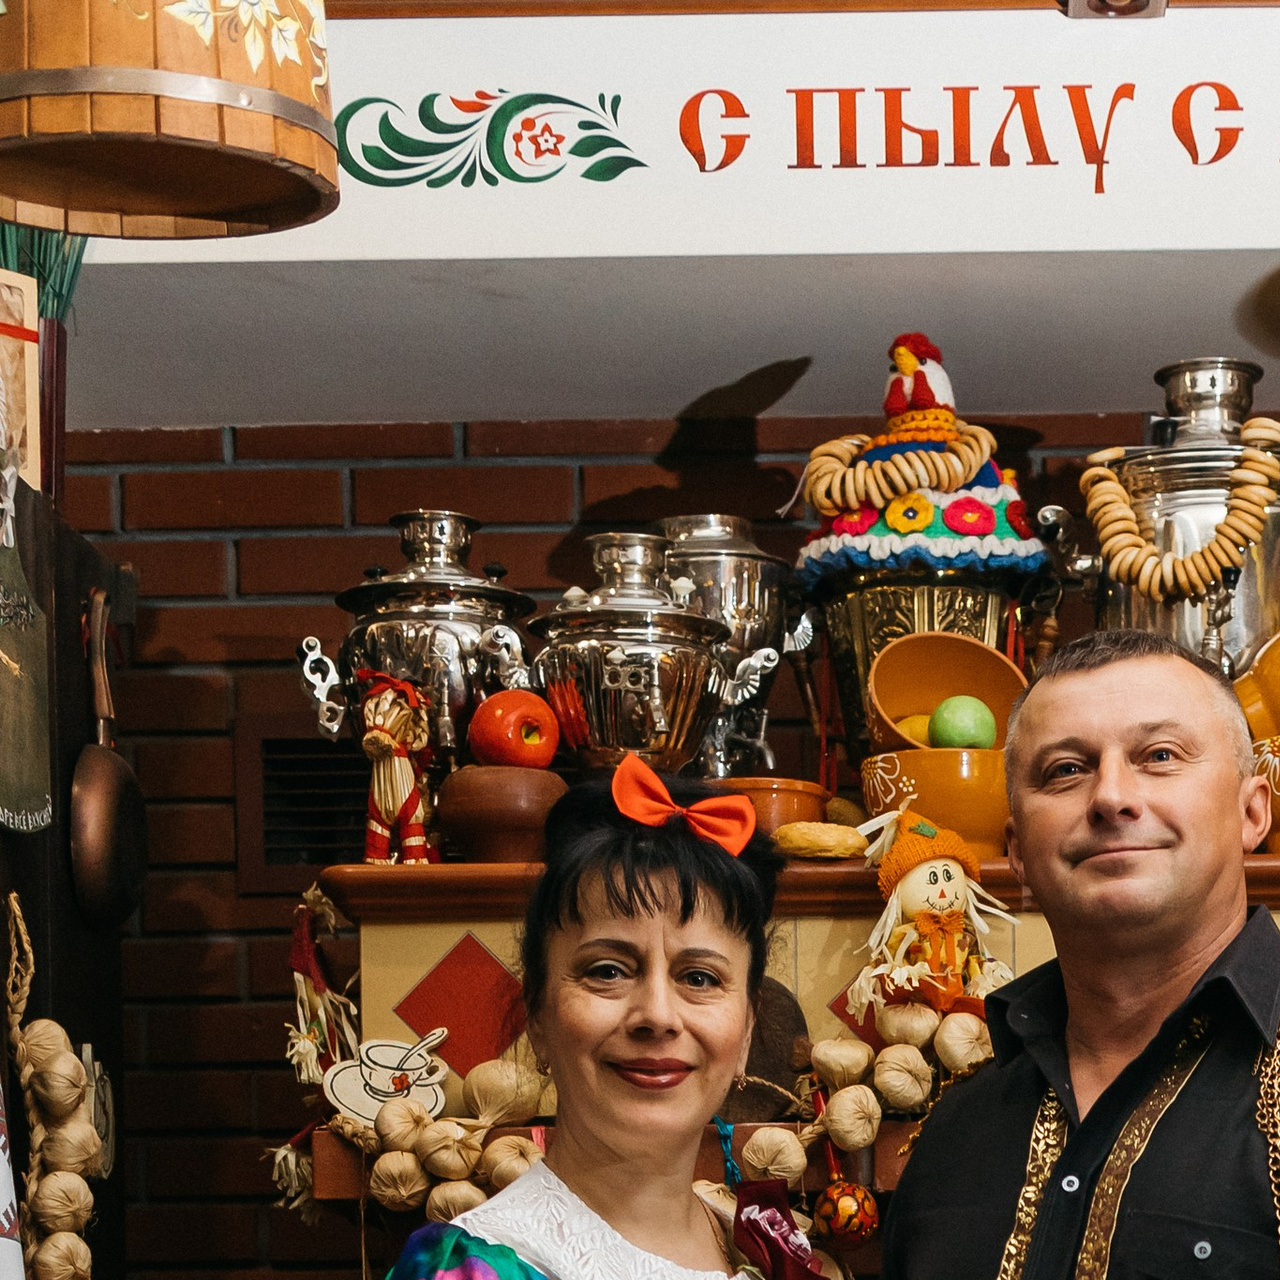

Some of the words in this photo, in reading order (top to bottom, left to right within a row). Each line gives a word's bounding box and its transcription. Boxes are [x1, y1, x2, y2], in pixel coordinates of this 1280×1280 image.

[679, 89, 750, 173] С
[786, 83, 1136, 194] ПЫЛУ
[1170, 81, 1244, 166] С
